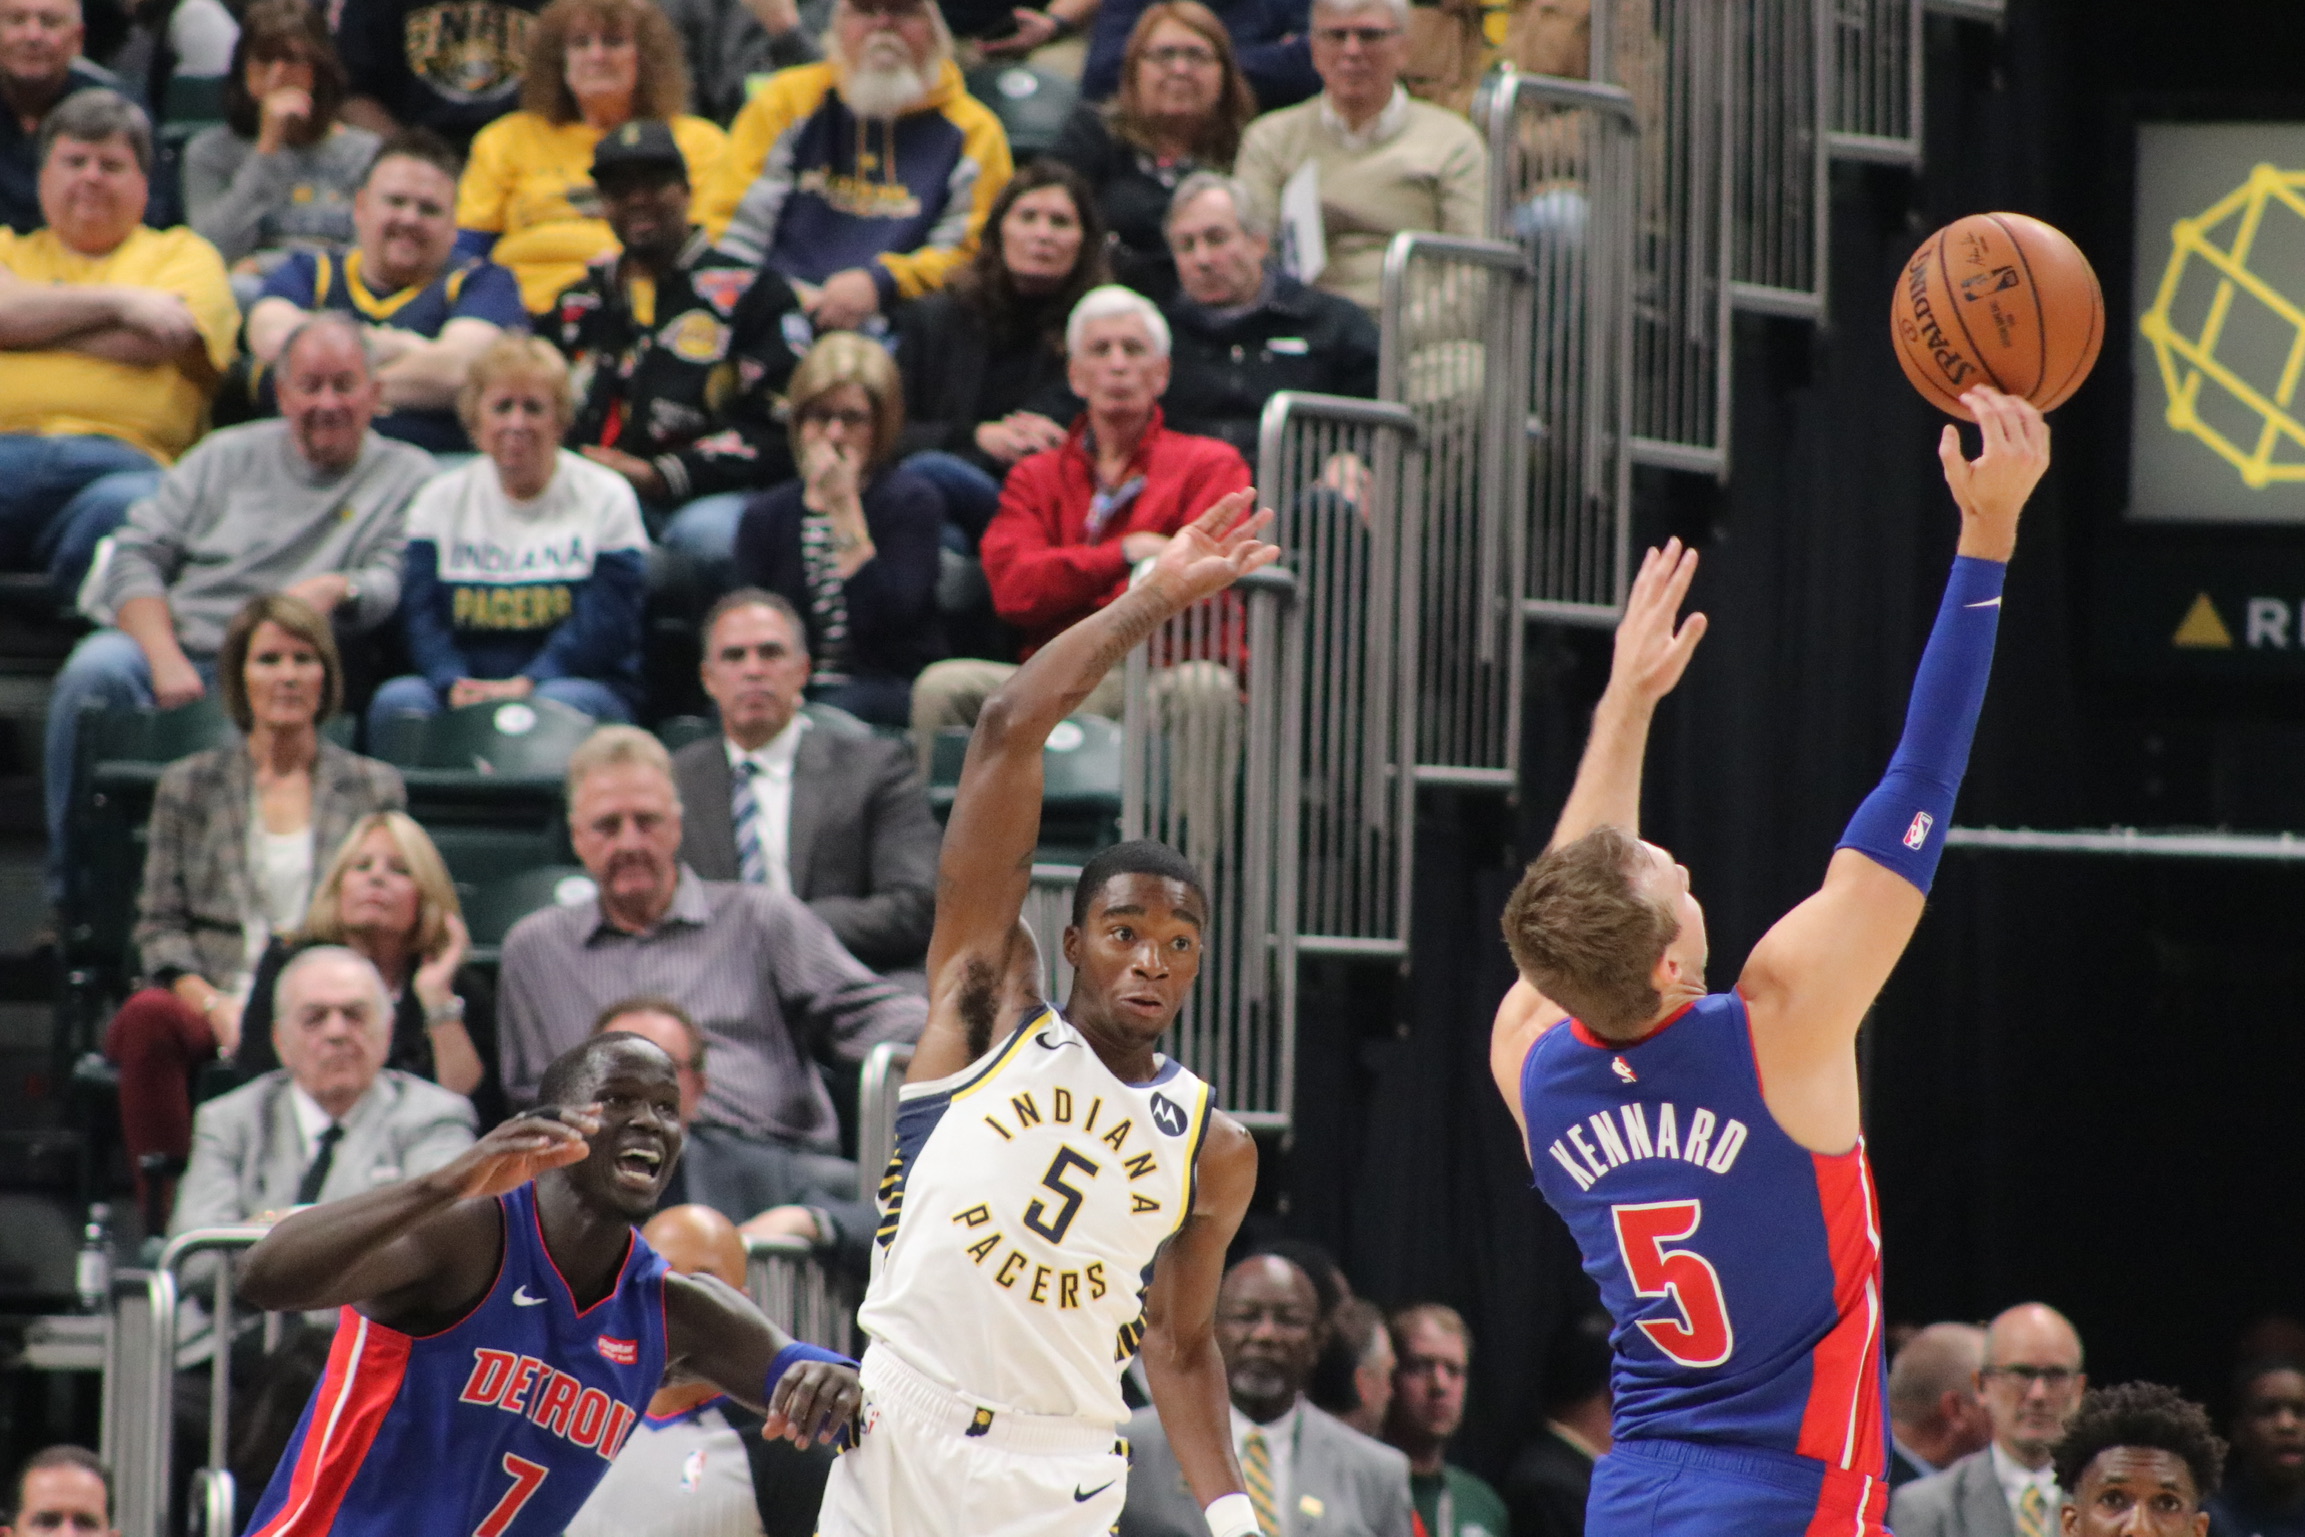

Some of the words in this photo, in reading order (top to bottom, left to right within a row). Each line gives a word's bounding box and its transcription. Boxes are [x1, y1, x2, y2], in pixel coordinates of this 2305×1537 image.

[1908, 245, 1976, 385] SPALDING
[452, 535, 588, 572] INDIANA
[2246, 597, 2305, 649] R
[983, 1085, 1162, 1217] INDIANA
[1022, 1142, 1101, 1246] 5
[1548, 1102, 1749, 1193] KENNARD
[951, 1201, 1108, 1310] PACERS
[1610, 1198, 1734, 1369] 5
[470, 1450, 550, 1537] 7
